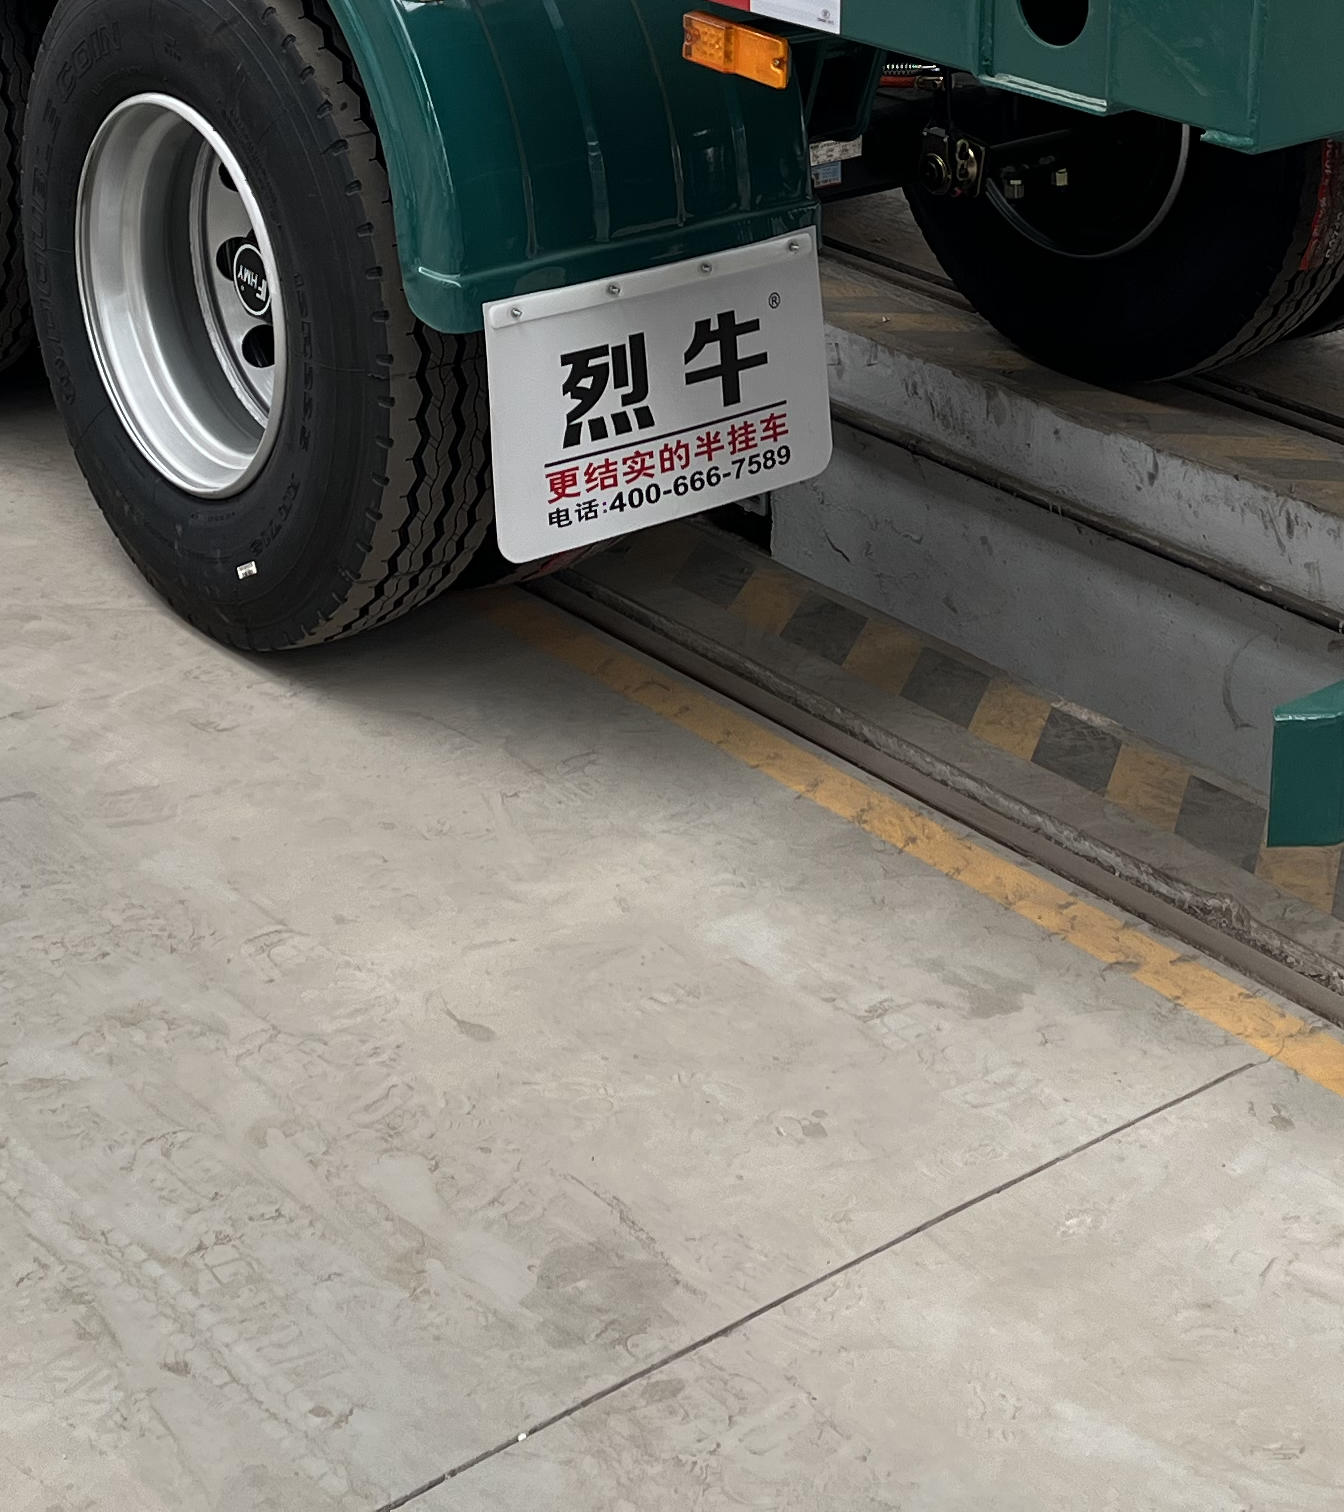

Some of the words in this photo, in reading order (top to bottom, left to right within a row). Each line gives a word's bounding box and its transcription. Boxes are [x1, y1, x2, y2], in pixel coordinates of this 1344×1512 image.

[560, 309, 768, 449] 烈牛
[544, 413, 790, 505] 更结实的半挂车
